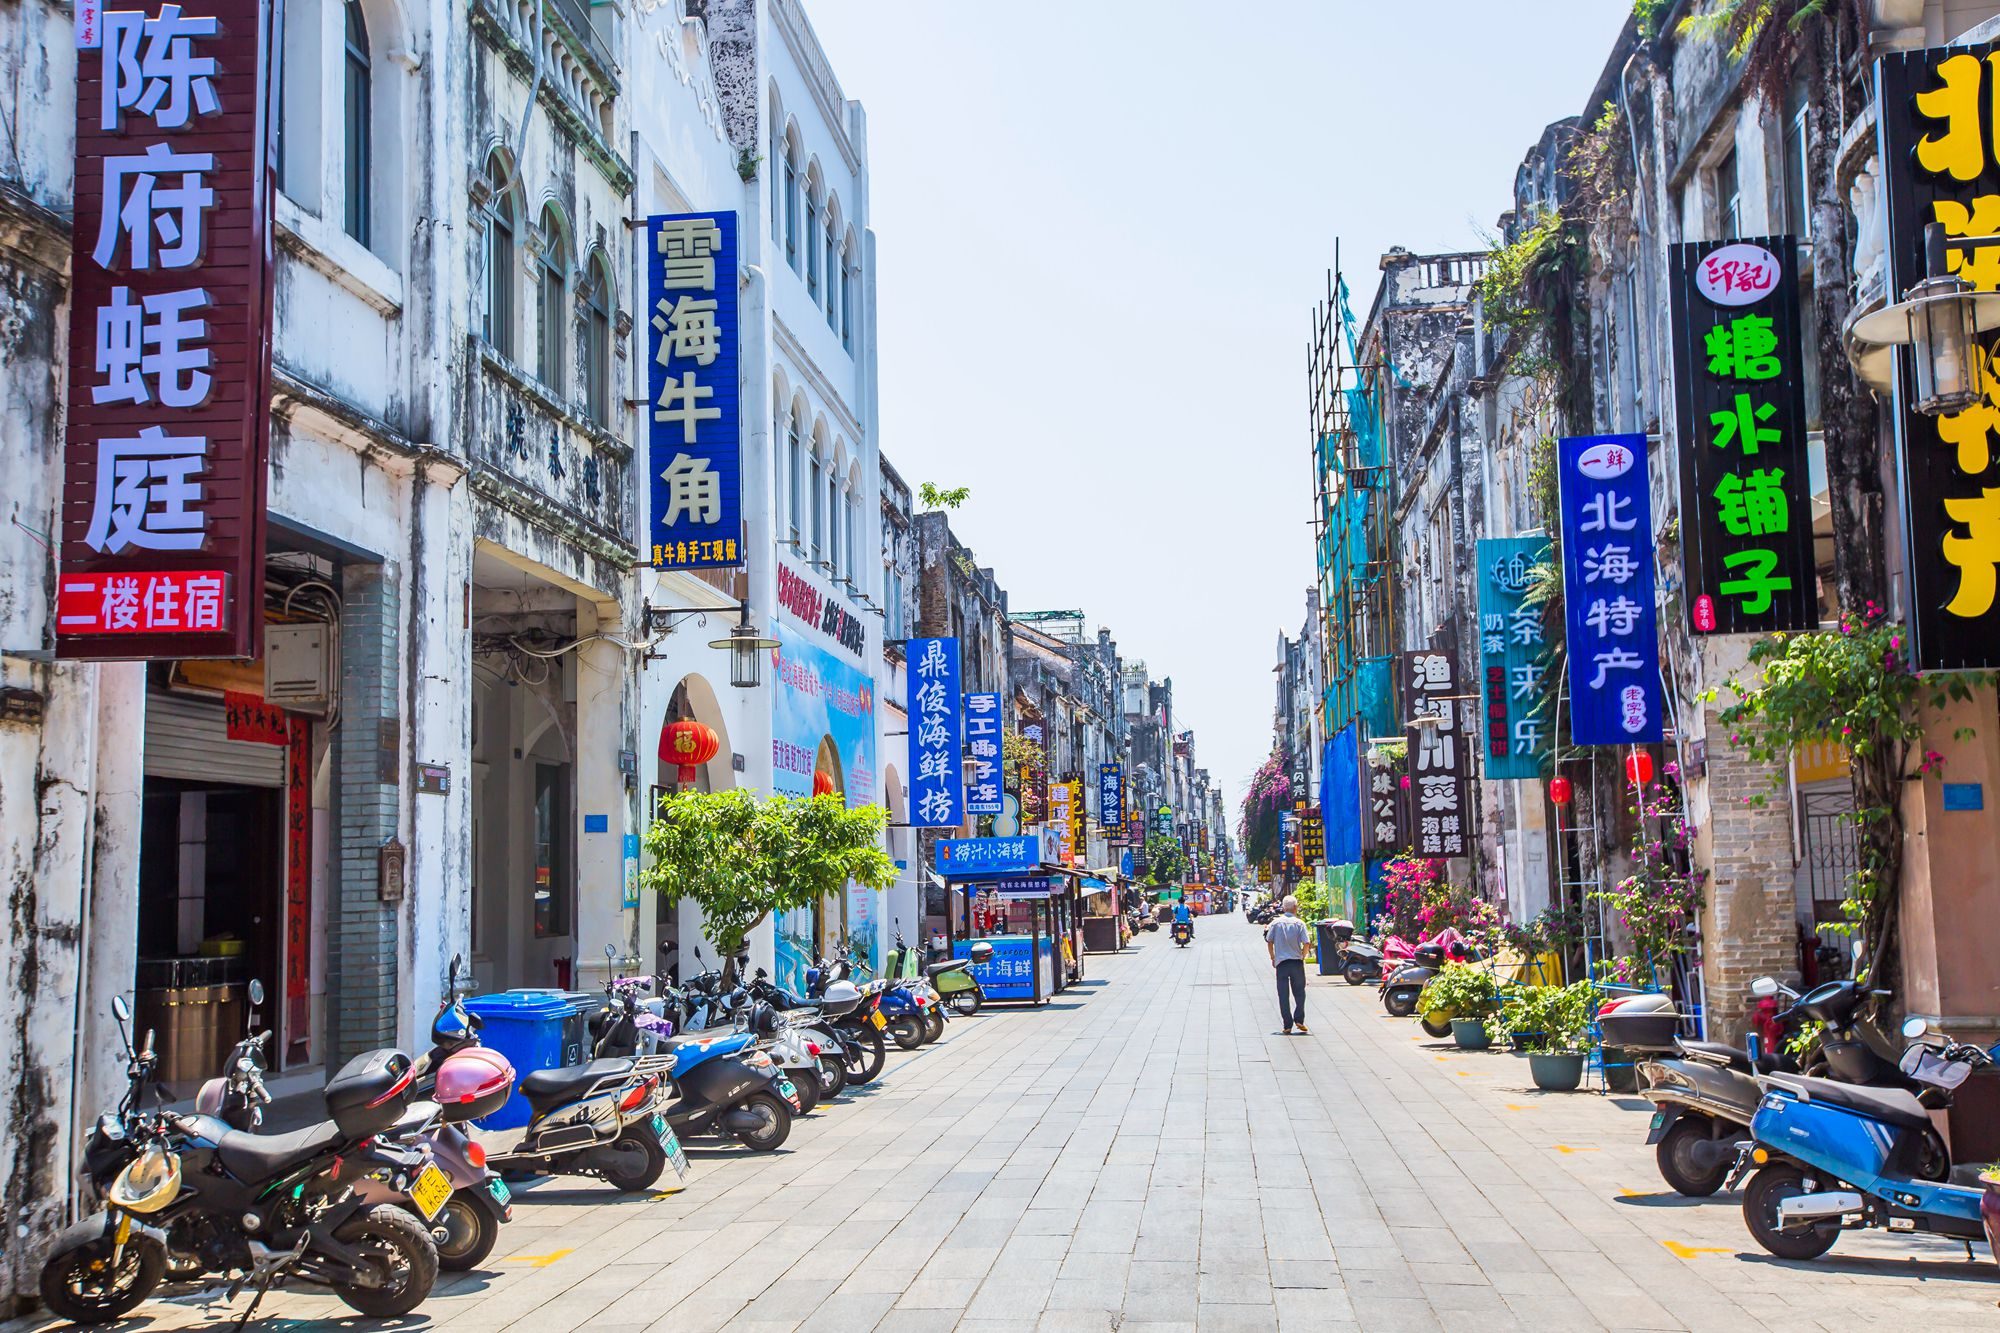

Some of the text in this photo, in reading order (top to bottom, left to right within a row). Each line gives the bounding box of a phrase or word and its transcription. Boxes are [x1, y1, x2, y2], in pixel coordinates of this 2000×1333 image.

[82, 0, 95, 45] 字号
[85, 4, 219, 556] 陈府蚝庭
[651, 218, 722, 526] 雪海牛角
[1582, 449, 1628, 473] 一鲜
[1704, 312, 1792, 614] 糖水铺子
[652, 539, 737, 567] 真牛角手工现做
[60, 575, 221, 630] 二楼住宿
[1581, 489, 1644, 690] 北海特产
[1483, 614, 1504, 655] 奶茶
[1626, 688, 1642, 728] 老字号
[673, 730, 697, 755] 福
[916, 639, 953, 824] 鼎俊海鲜捞
[1103, 775, 1118, 824] 海珍宝
[1421, 815, 1459, 836] 海鲜
[1422, 834, 1462, 853] 烧烤
[955, 840, 1027, 862] 捞汁小海鲜
